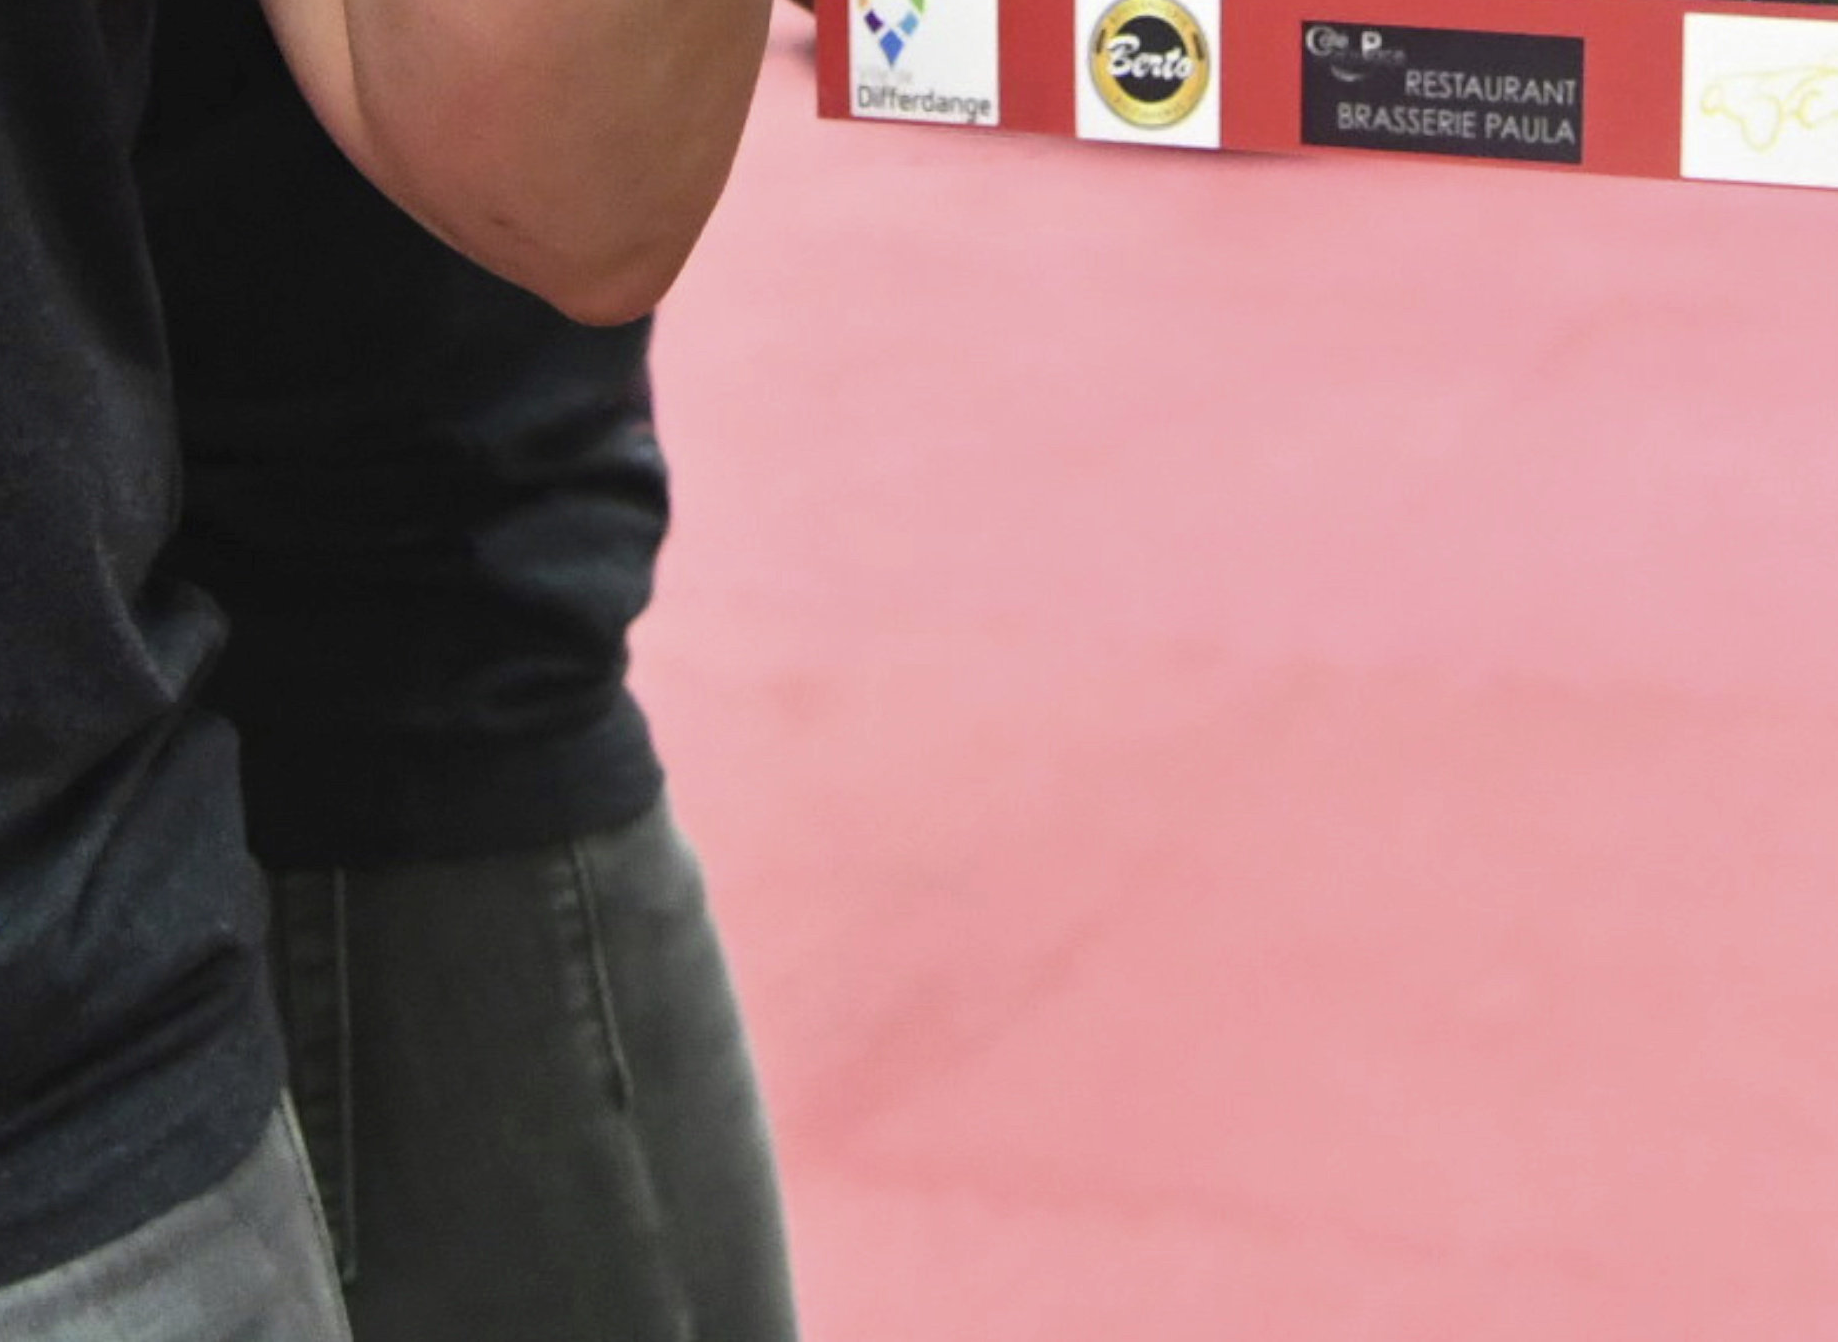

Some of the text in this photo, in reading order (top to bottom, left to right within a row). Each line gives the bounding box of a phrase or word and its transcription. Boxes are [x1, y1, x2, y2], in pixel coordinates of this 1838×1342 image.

[1107, 34, 1194, 81] Berto
[857, 85, 991, 123] Differdange
[1403, 69, 1576, 105] RESTAURANT
[1335, 101, 1576, 144] BRASSERIE PAULA
